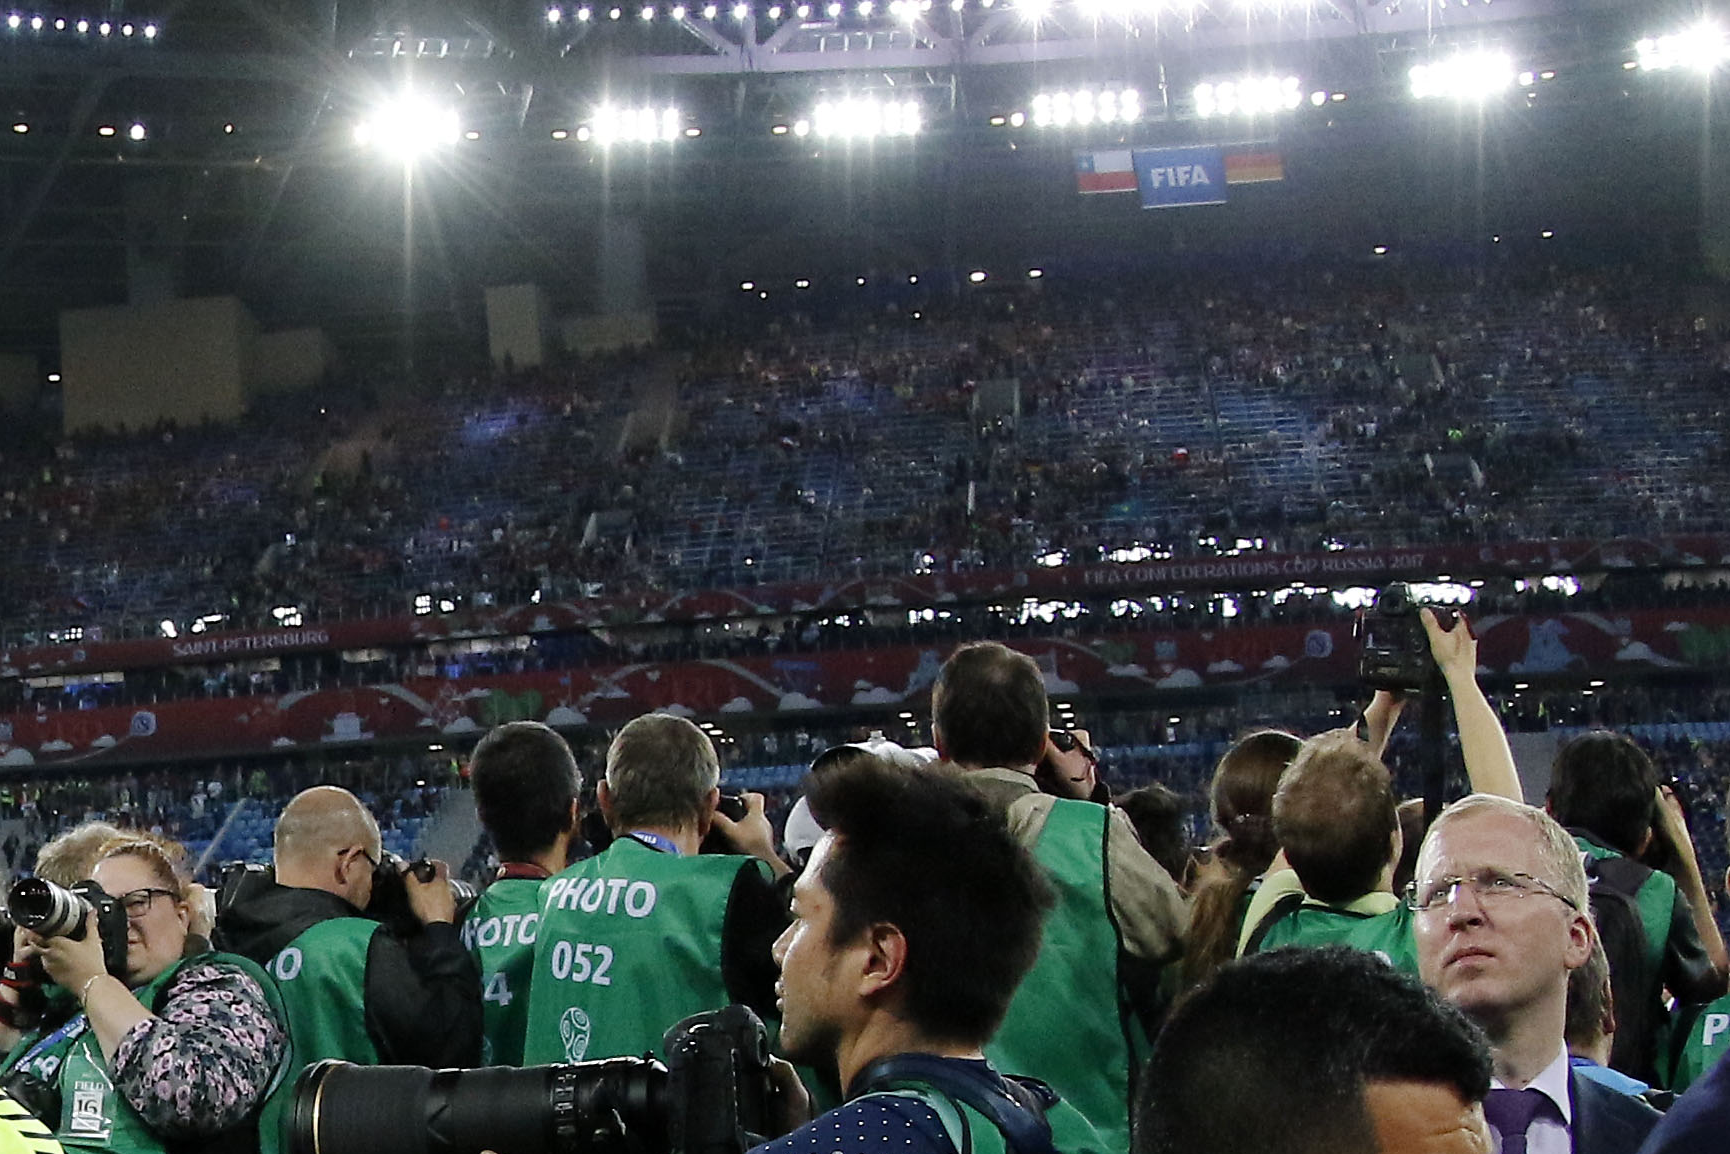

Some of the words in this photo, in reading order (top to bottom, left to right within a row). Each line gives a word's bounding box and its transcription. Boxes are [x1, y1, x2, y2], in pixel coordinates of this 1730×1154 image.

[1150, 165, 1210, 190] FIFA
[1084, 569, 1119, 585] FIFA
[1123, 561, 1274, 583] CONFEDERATIONS
[1321, 556, 1384, 573] RUSSIA
[545, 877, 657, 918] PHOTO
[551, 940, 614, 986] 052
[74, 1080, 104, 1091] FIELD
[77, 1099, 99, 1116] 16
